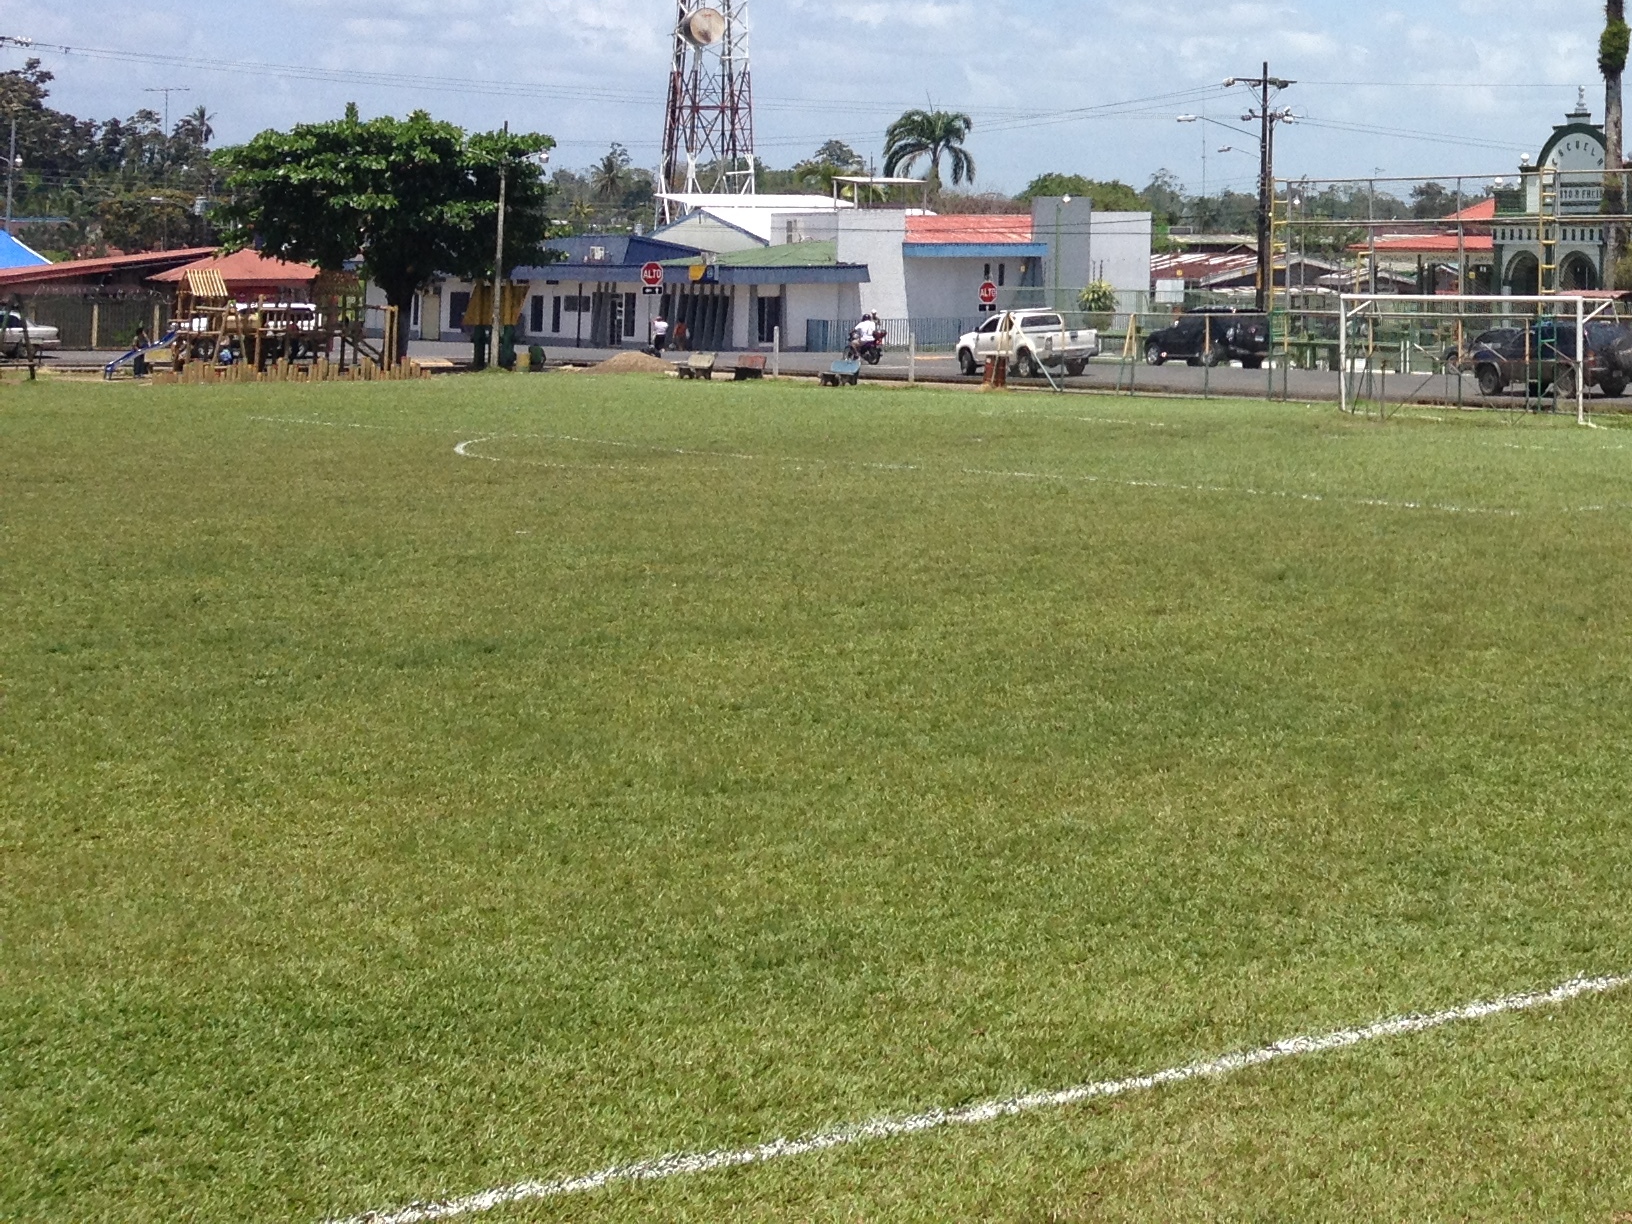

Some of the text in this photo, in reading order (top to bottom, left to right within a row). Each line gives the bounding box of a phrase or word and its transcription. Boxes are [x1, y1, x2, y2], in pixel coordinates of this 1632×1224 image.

[1551, 140, 1604, 166] ESCUELA
[643, 268, 662, 279] ALTO
[980, 288, 996, 297] ALTO
